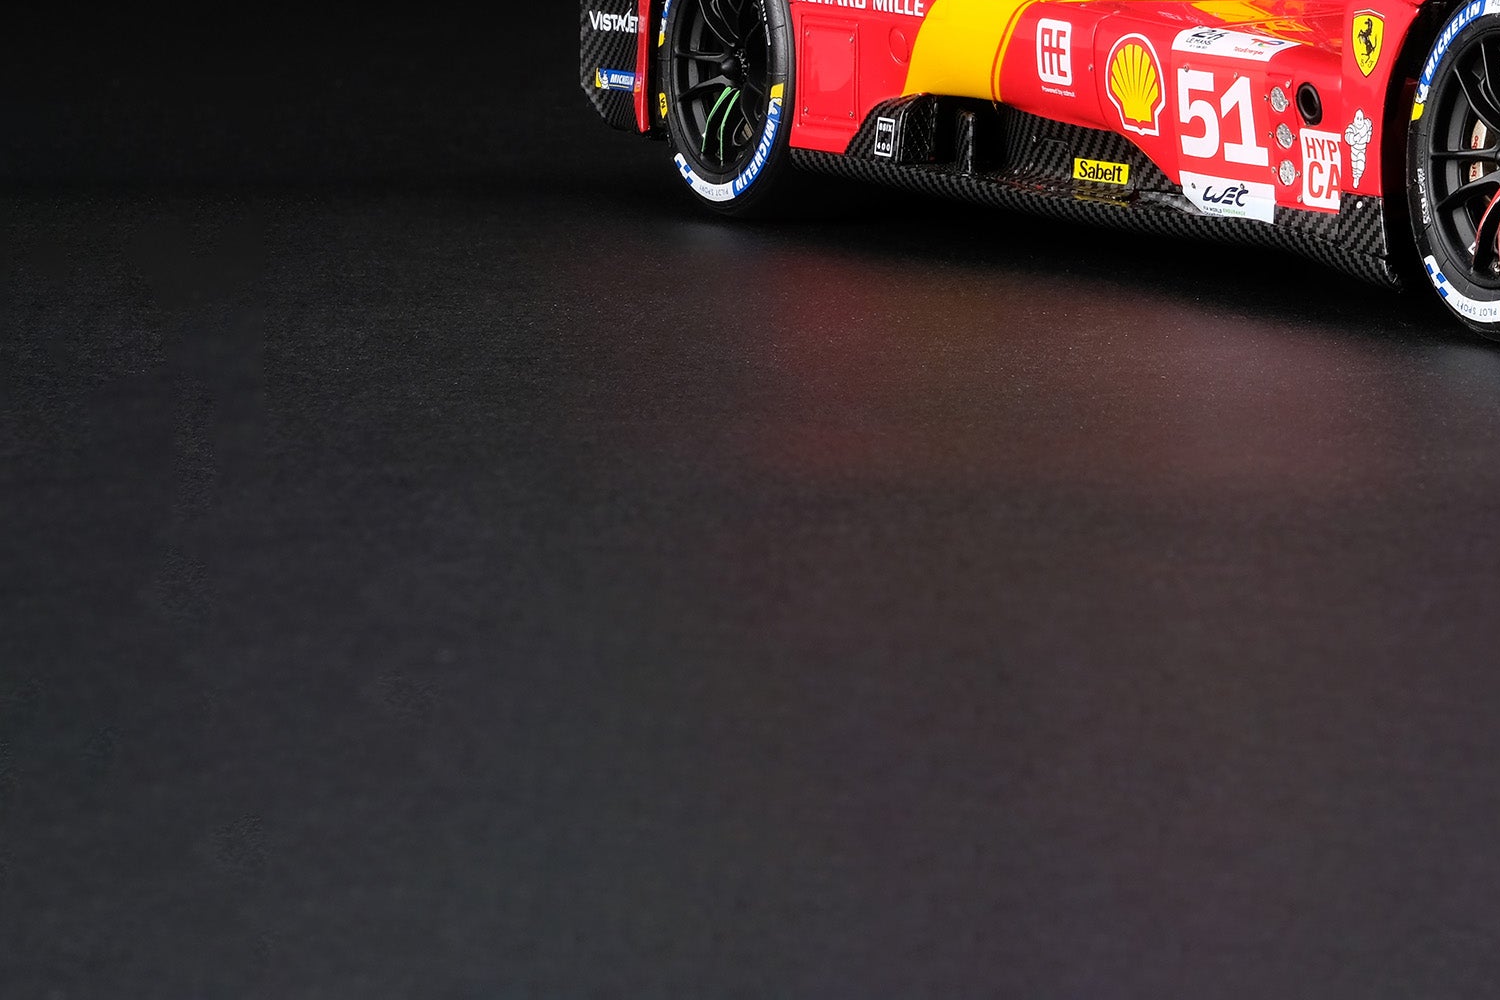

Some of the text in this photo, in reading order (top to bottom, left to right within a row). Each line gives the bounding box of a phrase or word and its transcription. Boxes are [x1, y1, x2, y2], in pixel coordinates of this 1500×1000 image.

[1425, 1, 1480, 81] MICHELIN
[1176, 67, 1269, 168] 51
[735, 119, 775, 192] MICHELIN
[1305, 136, 1341, 161] HYP
[1079, 160, 1123, 182] Sabelt
[1203, 186, 1249, 207] WEC
[1457, 301, 1497, 316] PILOT SPORT
